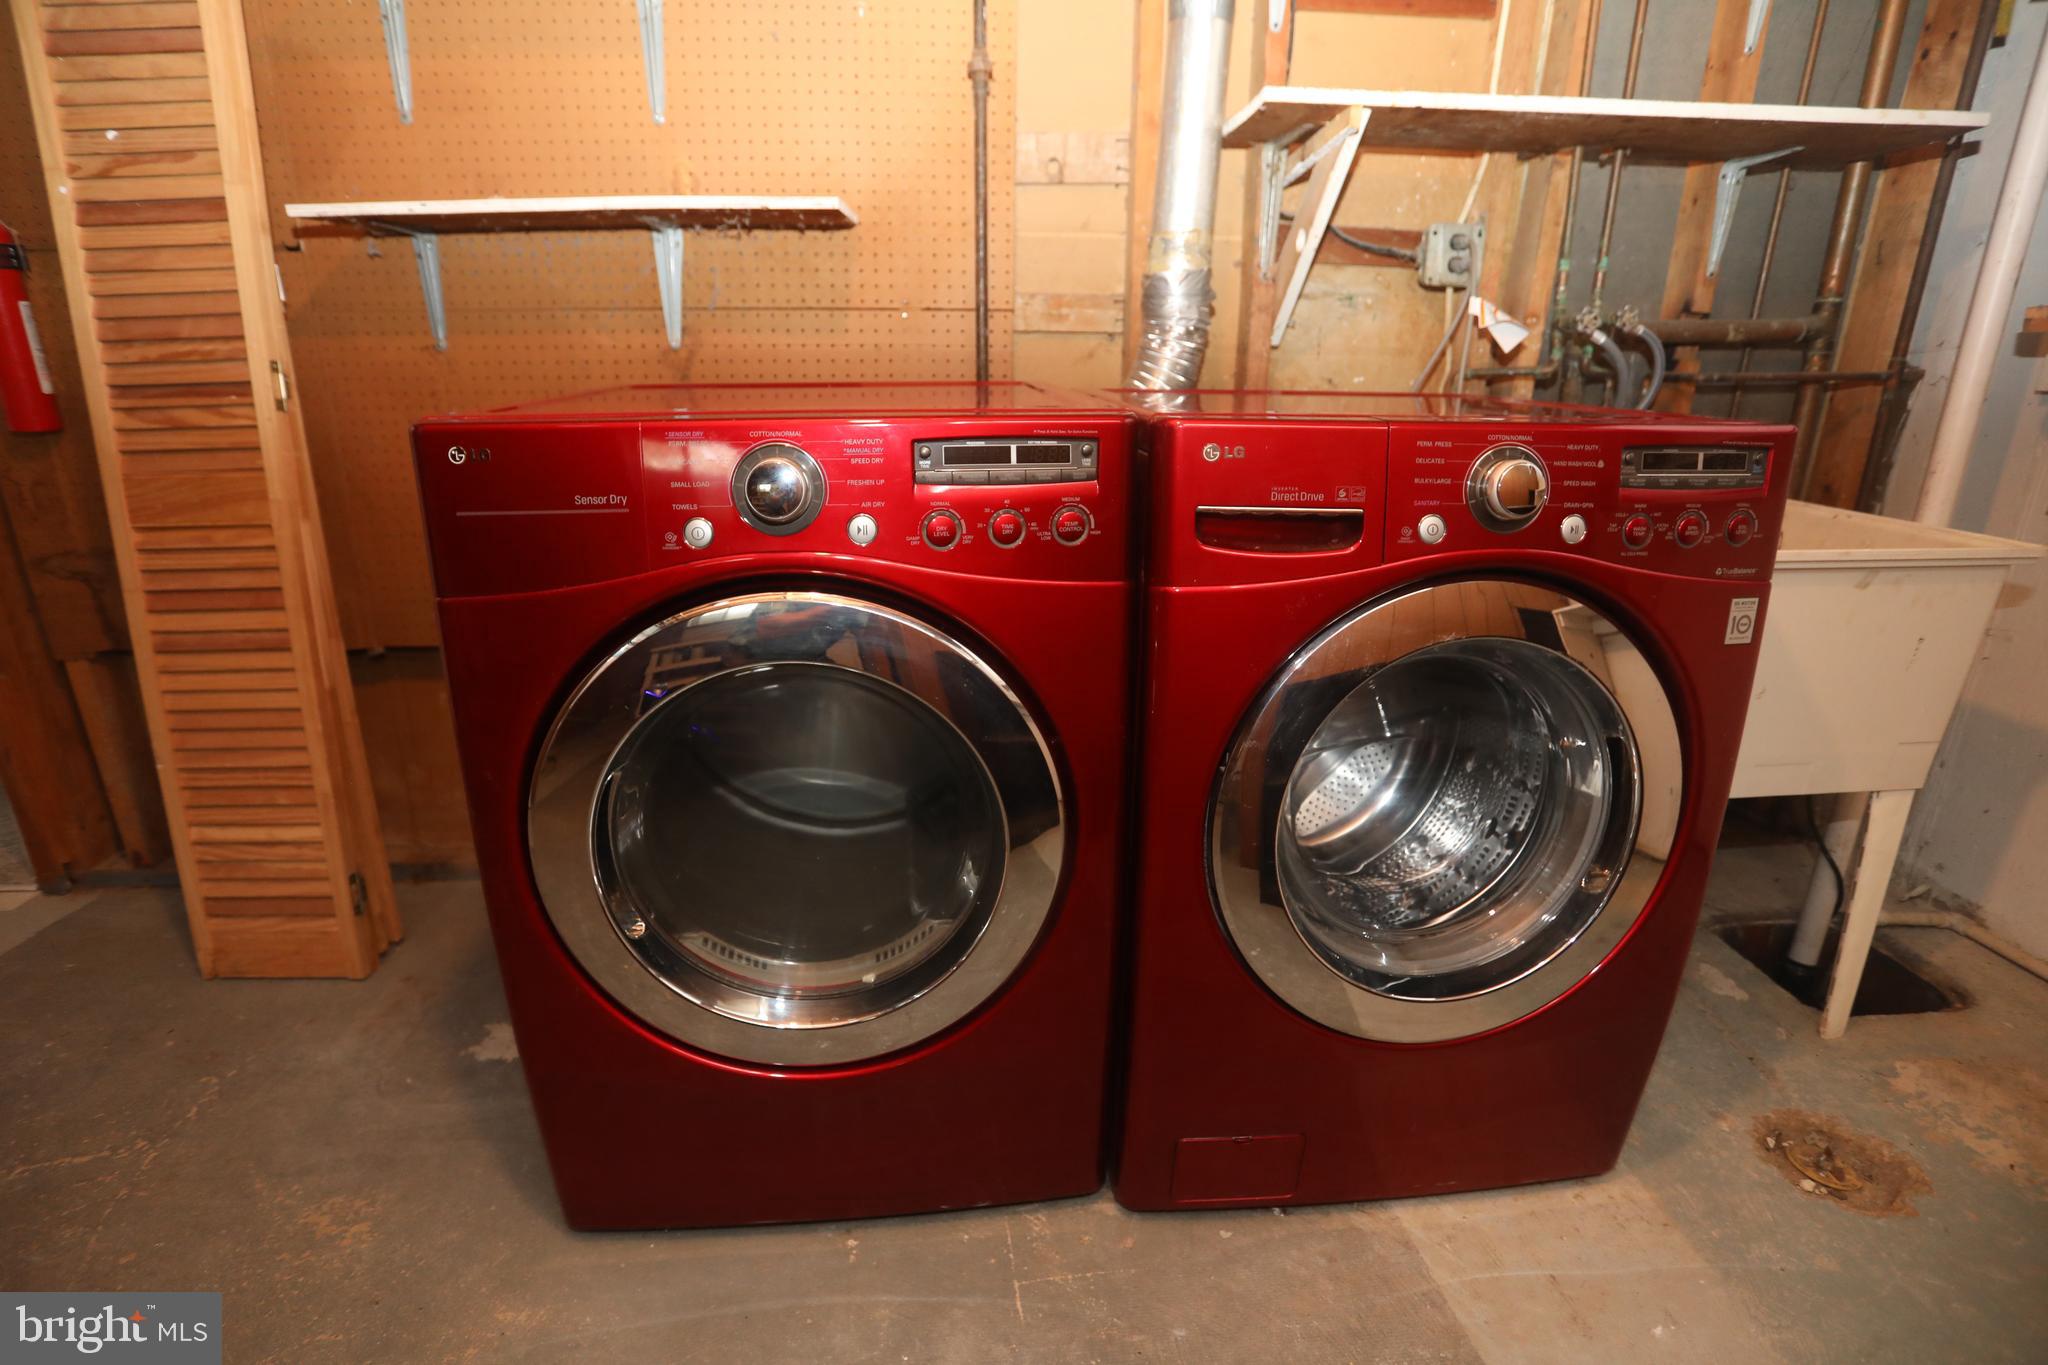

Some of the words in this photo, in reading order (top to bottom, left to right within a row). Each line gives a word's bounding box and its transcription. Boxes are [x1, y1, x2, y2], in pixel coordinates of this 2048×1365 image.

[574, 495, 608, 505] Sensor
[610, 494, 628, 506] Dry
[1271, 492, 1299, 501] Direct
[1300, 492, 1324, 502] Drive
